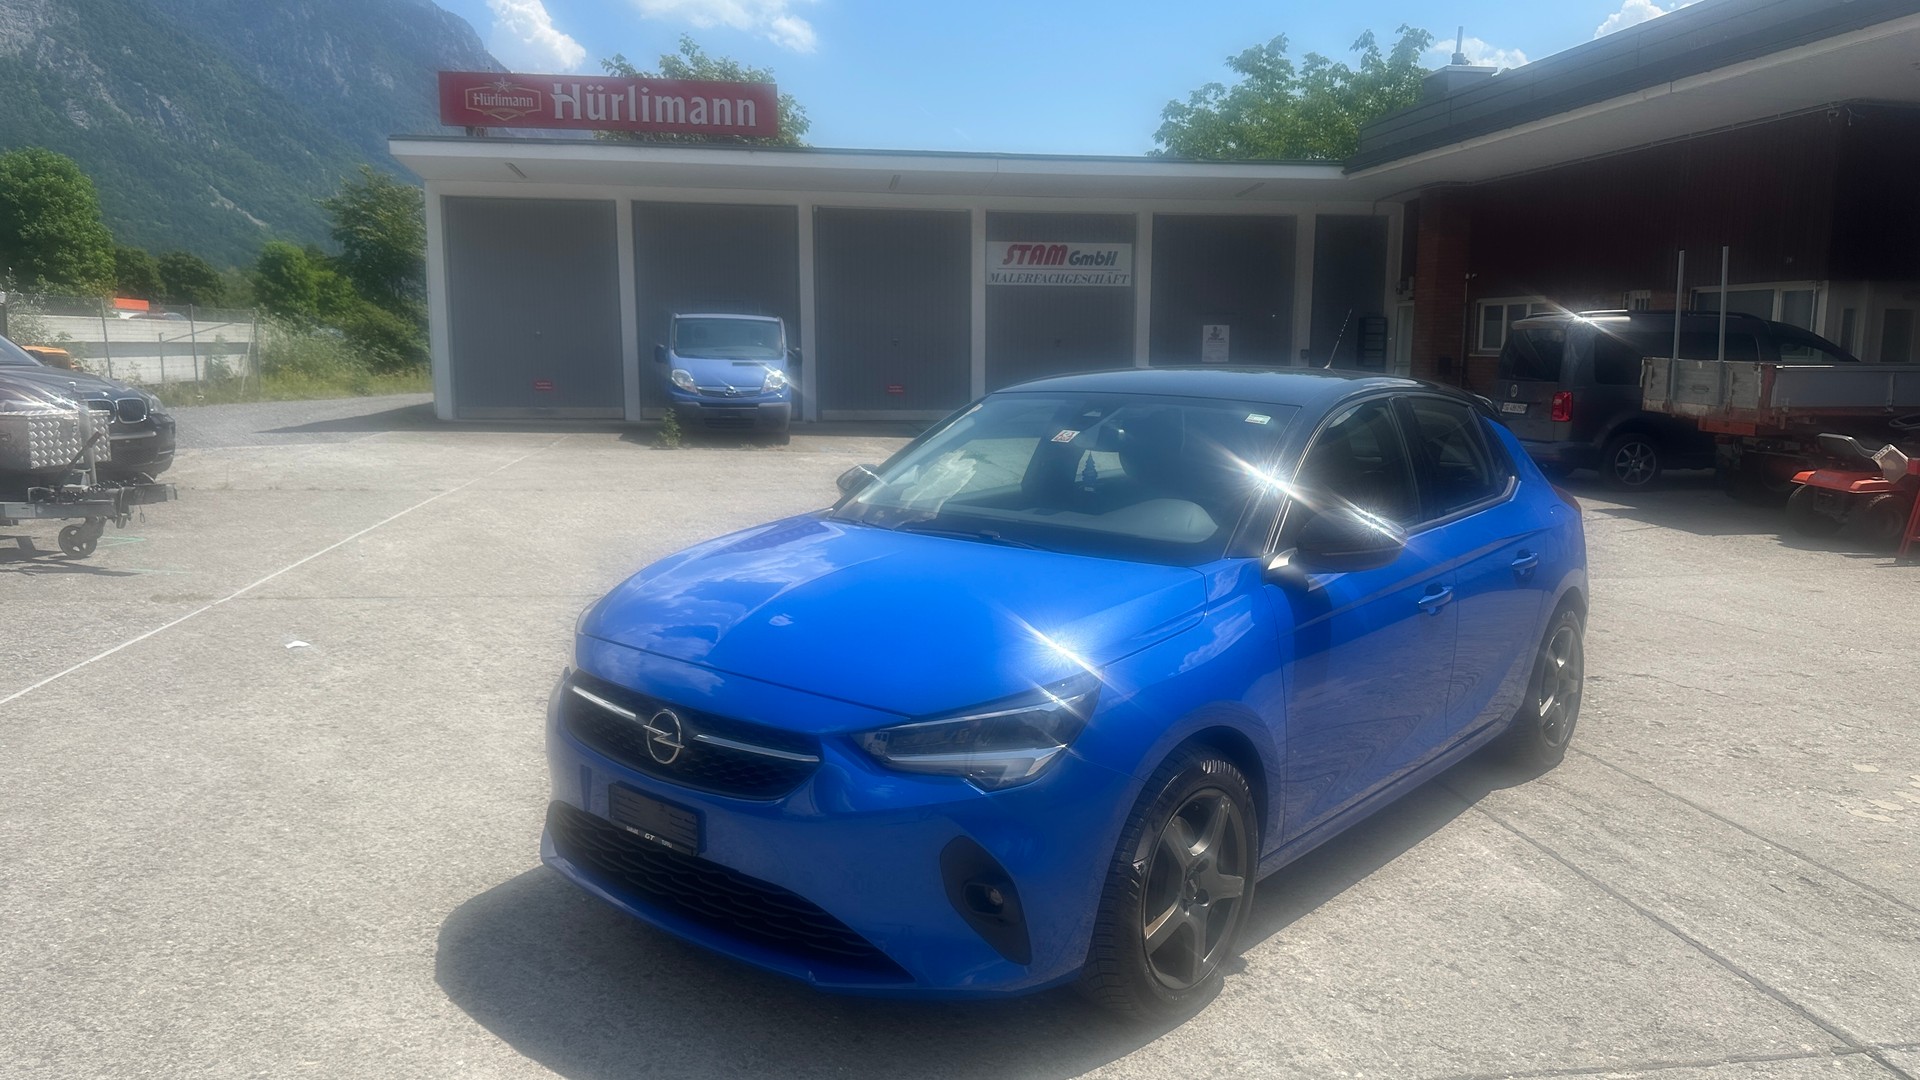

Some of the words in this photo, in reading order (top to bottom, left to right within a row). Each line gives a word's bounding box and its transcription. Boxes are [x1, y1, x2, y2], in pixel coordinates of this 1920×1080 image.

[472, 92, 534, 107] Hürlimann
[550, 82, 757, 127] Hürlimann
[1002, 244, 1068, 266] STAM
[1068, 251, 1118, 266] GmbH
[988, 272, 1130, 285] MALERFACHGESCHÄFT
